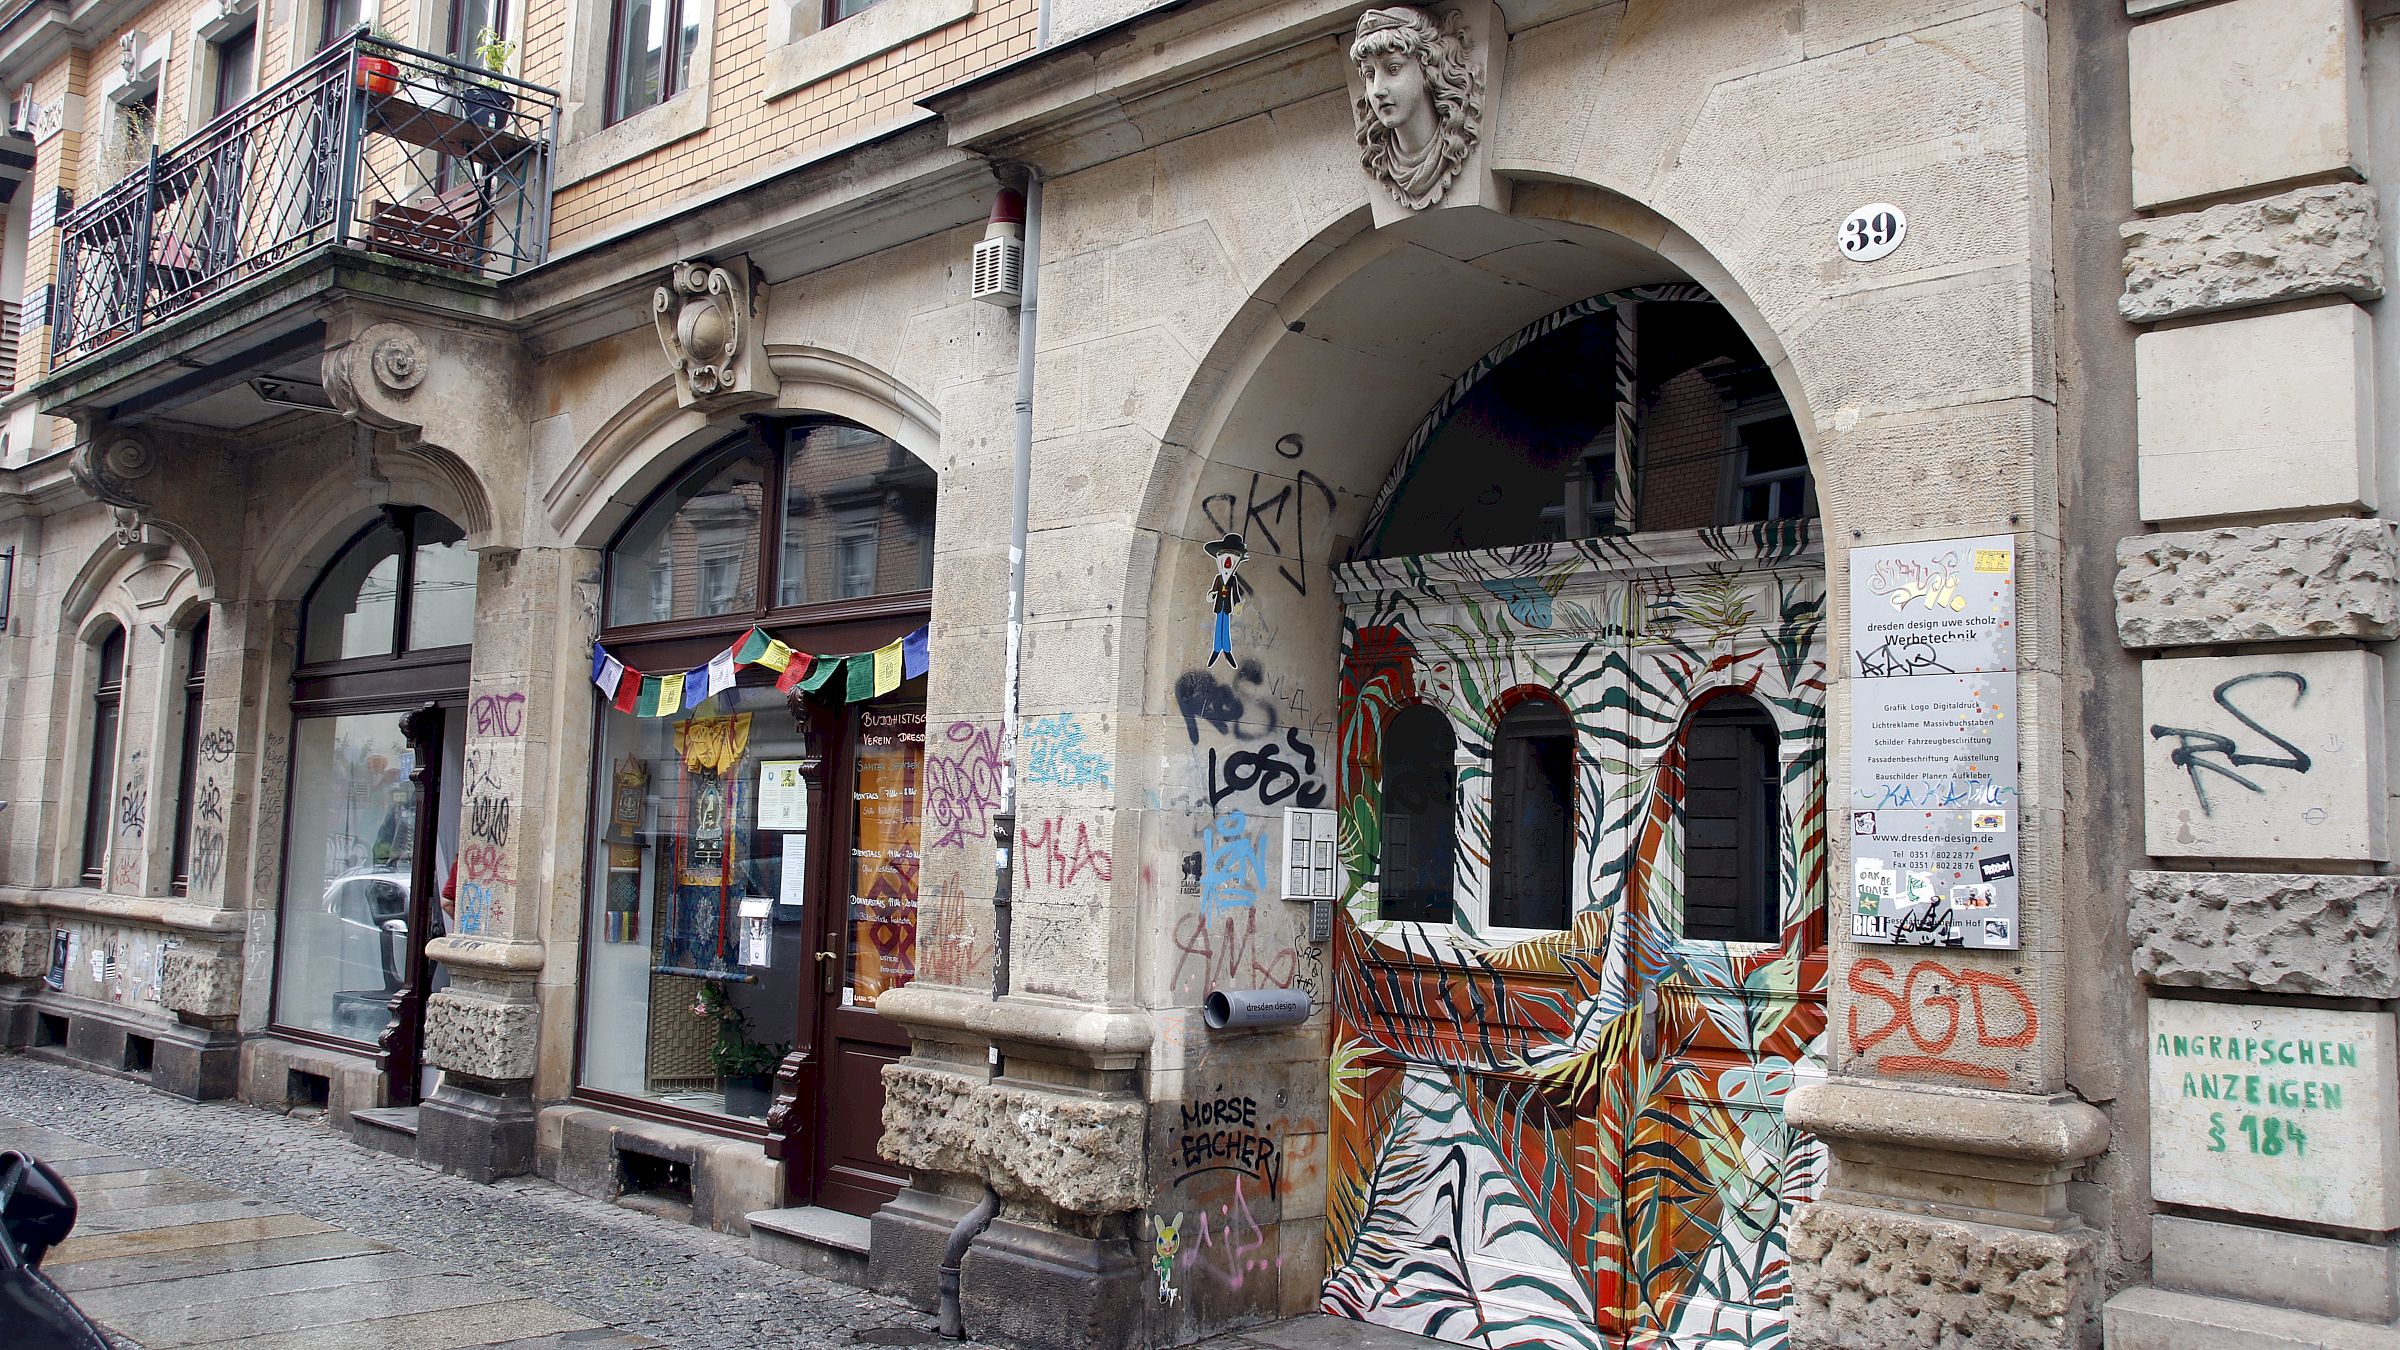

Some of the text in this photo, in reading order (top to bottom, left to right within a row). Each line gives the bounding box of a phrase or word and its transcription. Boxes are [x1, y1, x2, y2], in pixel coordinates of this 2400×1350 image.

[1847, 212, 1896, 251] 39
[1867, 615, 1996, 632] dresden design uwe scholz
[1885, 629, 1977, 645] Werbetechnik
[1884, 703, 1907, 711] Grafik
[1933, 701, 1980, 710] Digitaldruck
[862, 711, 926, 727] BUDDHISTISC
[1872, 719, 1994, 729] Lichtreklame Massivbuchstaben
[863, 733, 892, 745] VEREIN
[1874, 737, 1991, 746] Schilder Fahrzeugbeschriftung
[1868, 754, 1999, 763] Fassadenbeschriftung Ausstellung
[1952, 771, 1991, 779] Aufkleber
[1872, 833, 1994, 844] www.dresden-design.de
[1910, 851, 1928, 859] 0351
[1936, 851, 1951, 859] 802
[1952, 851, 1964, 859] 28
[1965, 851, 1974, 859] 77
[1893, 861, 1906, 869] Fax
[1910, 861, 1928, 869] 0351
[1936, 861, 1951, 869] 802
[1952, 861, 1964, 869] 28
[1965, 861, 1974, 869] 76
[1966, 919, 1981, 927] Hof
[1246, 1001, 1297, 1012] dresden design
[2156, 1033, 2357, 1067] ANGRAPSCHEN
[2183, 1072, 2342, 1109] ANZEIGEN
[2207, 1112, 2307, 1156] § 184
